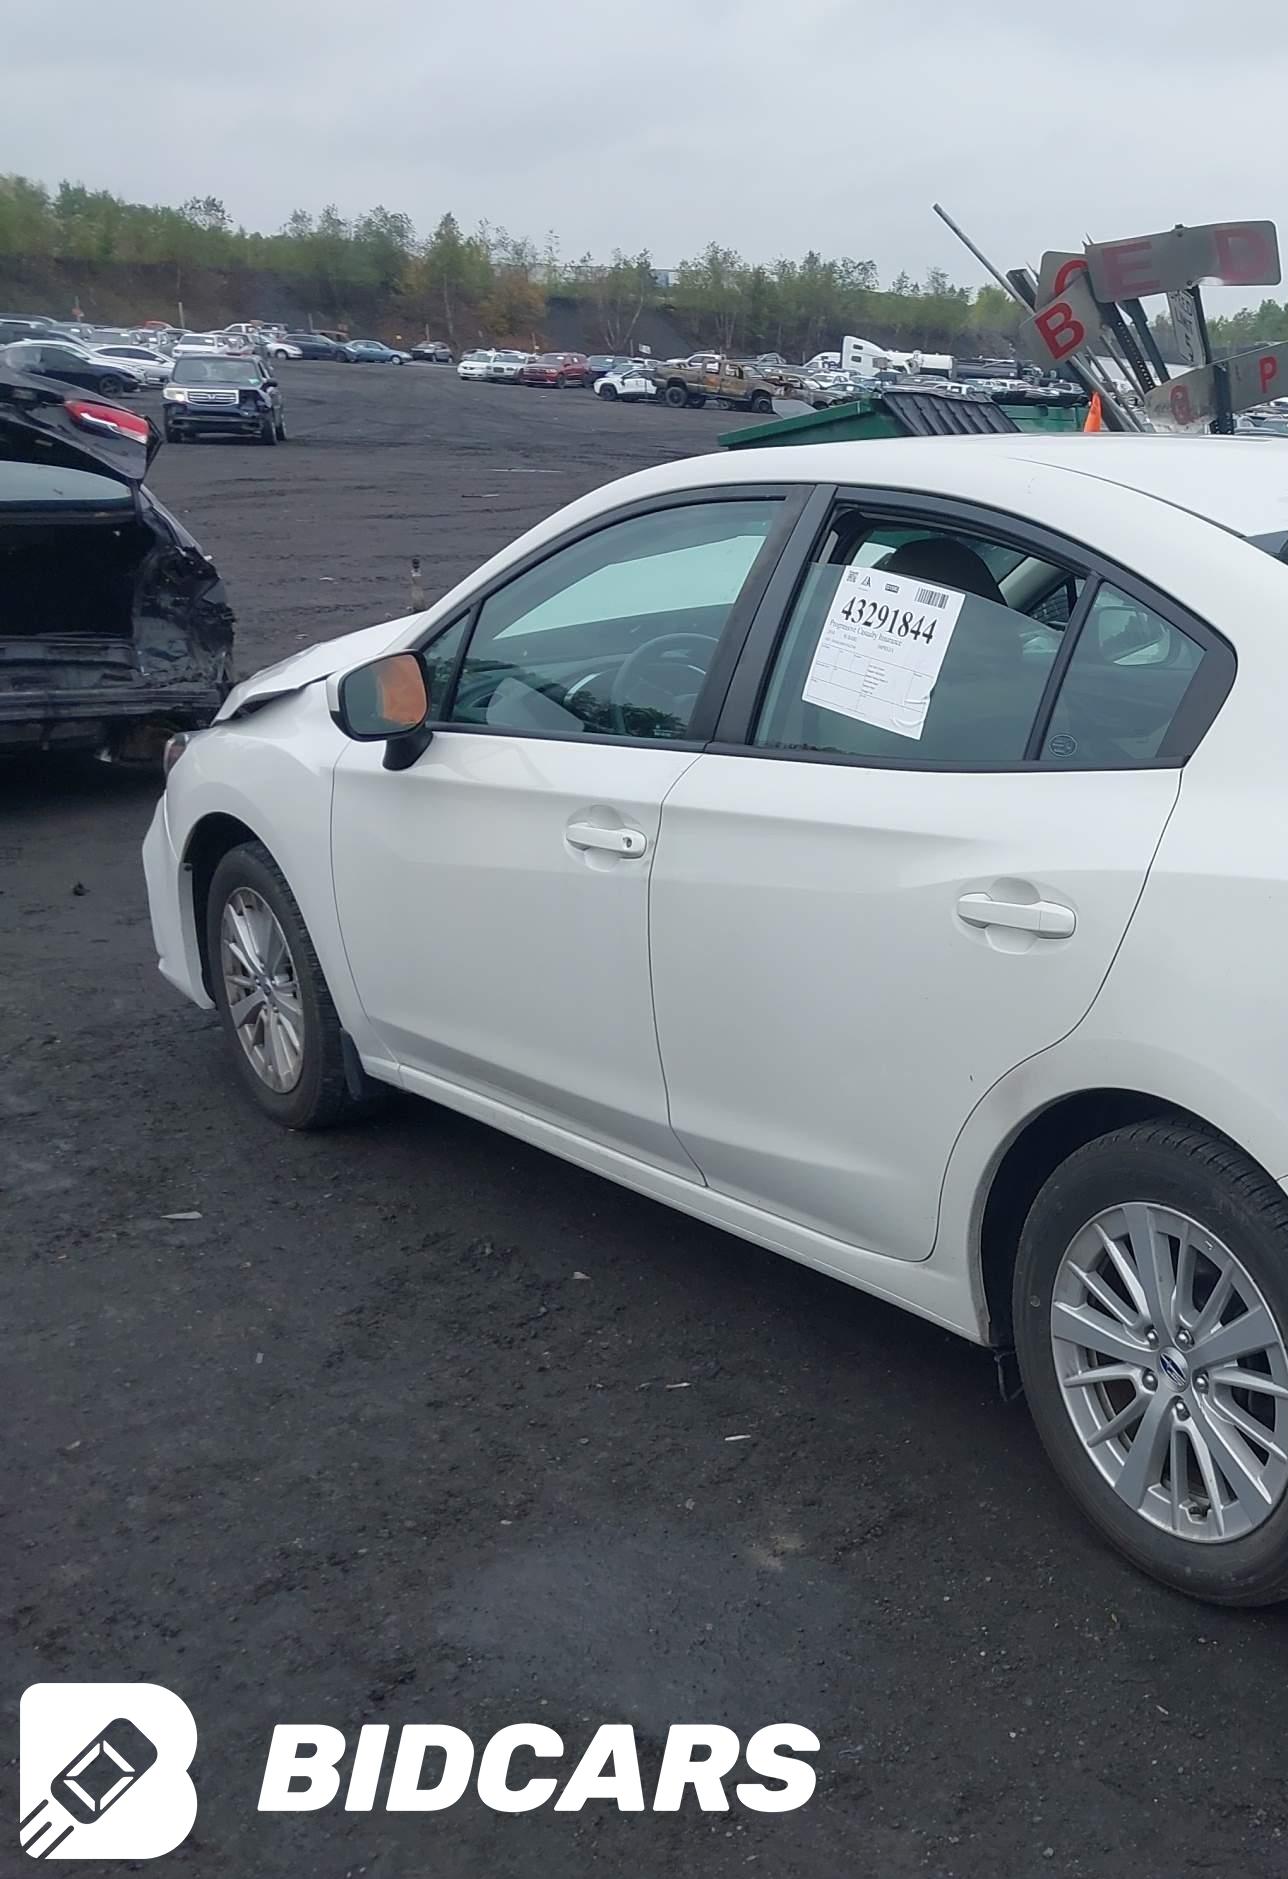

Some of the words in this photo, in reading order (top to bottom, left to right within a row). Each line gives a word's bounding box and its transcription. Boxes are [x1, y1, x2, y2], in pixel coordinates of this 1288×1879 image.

[1102, 241, 1160, 293] E
[1213, 227, 1269, 280] D
[1034, 301, 1085, 361] B
[1258, 355, 1278, 394] P
[841, 596, 938, 645] 43291844
